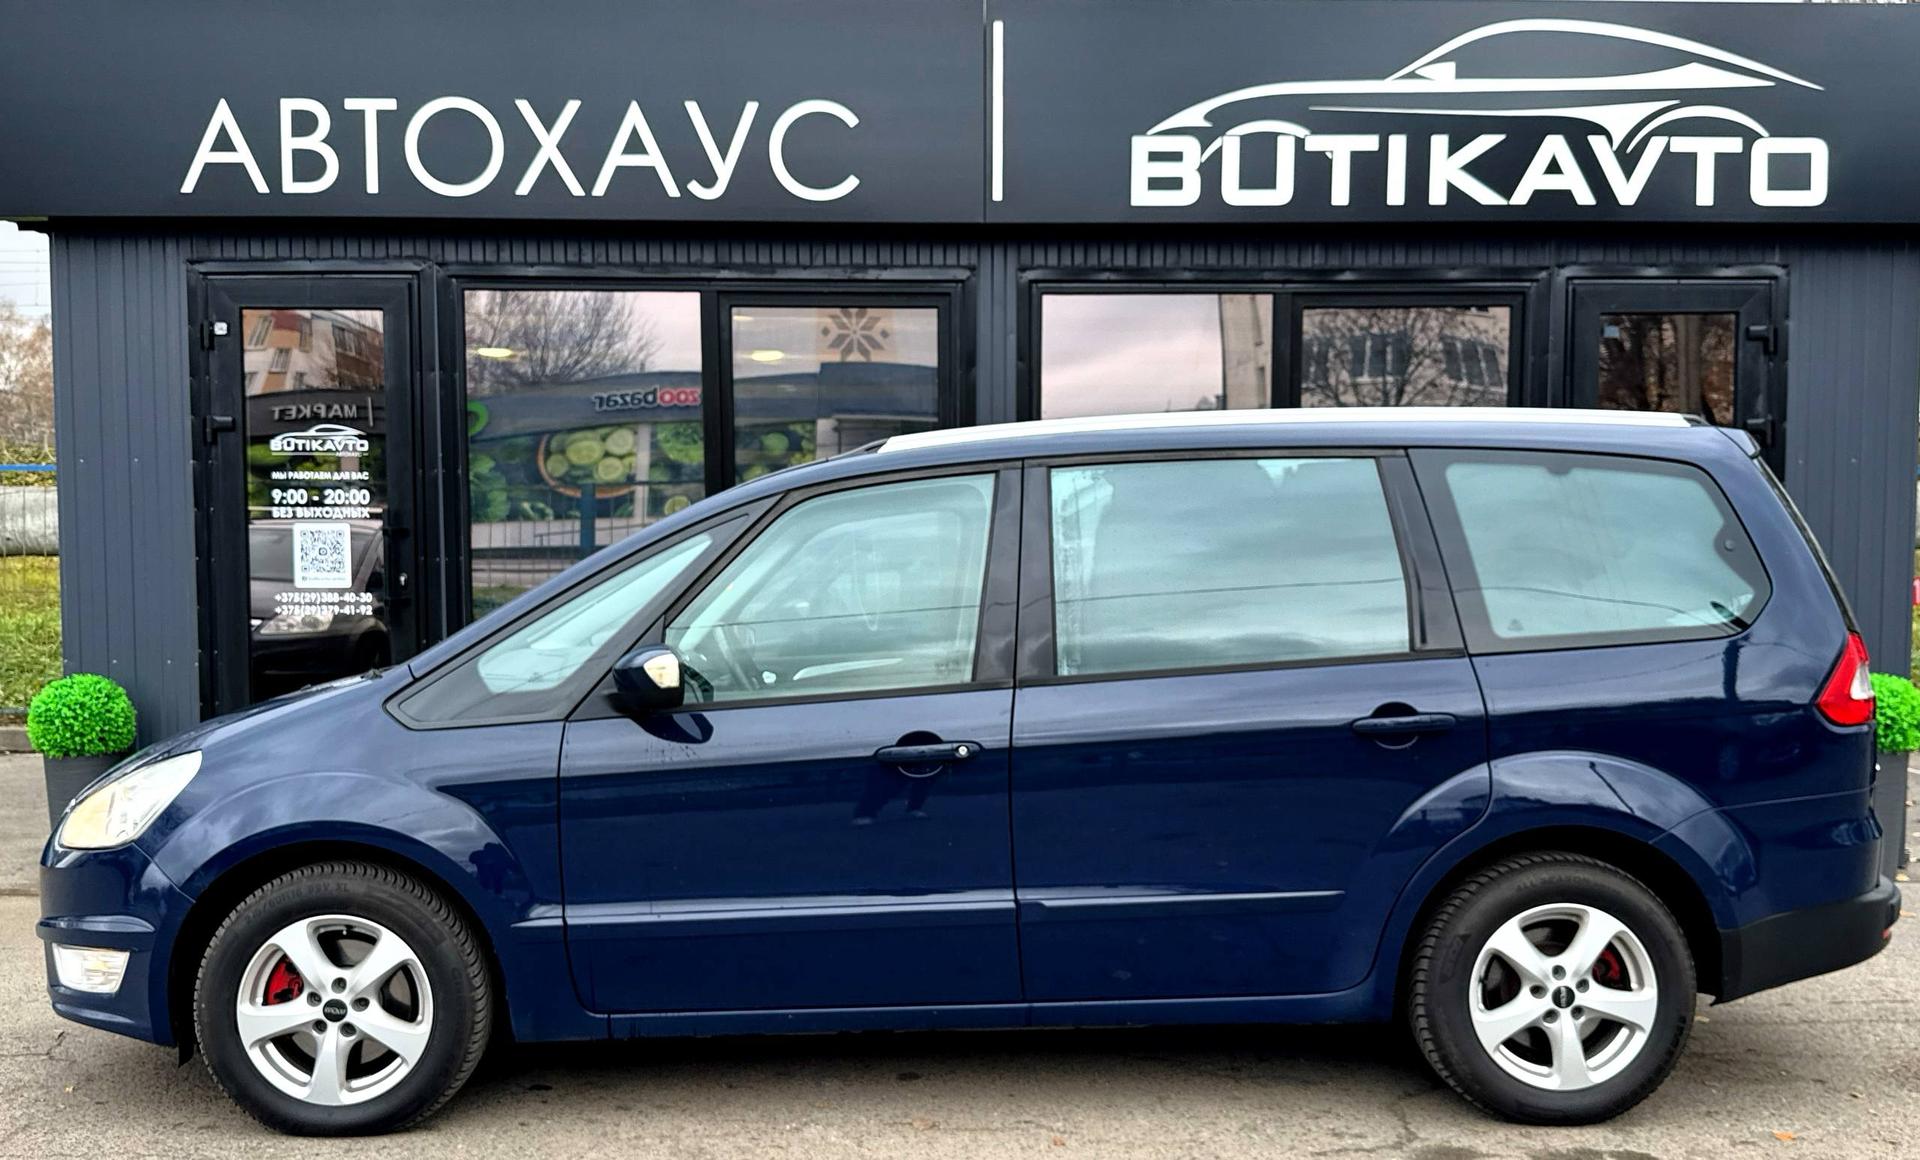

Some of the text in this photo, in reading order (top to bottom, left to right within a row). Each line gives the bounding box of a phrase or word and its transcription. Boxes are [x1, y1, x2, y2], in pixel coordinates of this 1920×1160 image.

[180, 96, 861, 201] АВТОХАУС
[1130, 133, 1830, 207] BUTIKAVTO
[270, 439, 369, 452] BUTIKAVTO
[271, 471, 287, 480] МЫ
[288, 471, 332, 480] РАБОТАЕМ
[351, 471, 369, 480] ВАС
[271, 488, 309, 505] 9:00
[323, 488, 371, 505] 20:00
[272, 506, 370, 519] БЕЗ ВЫХОДНЫХ
